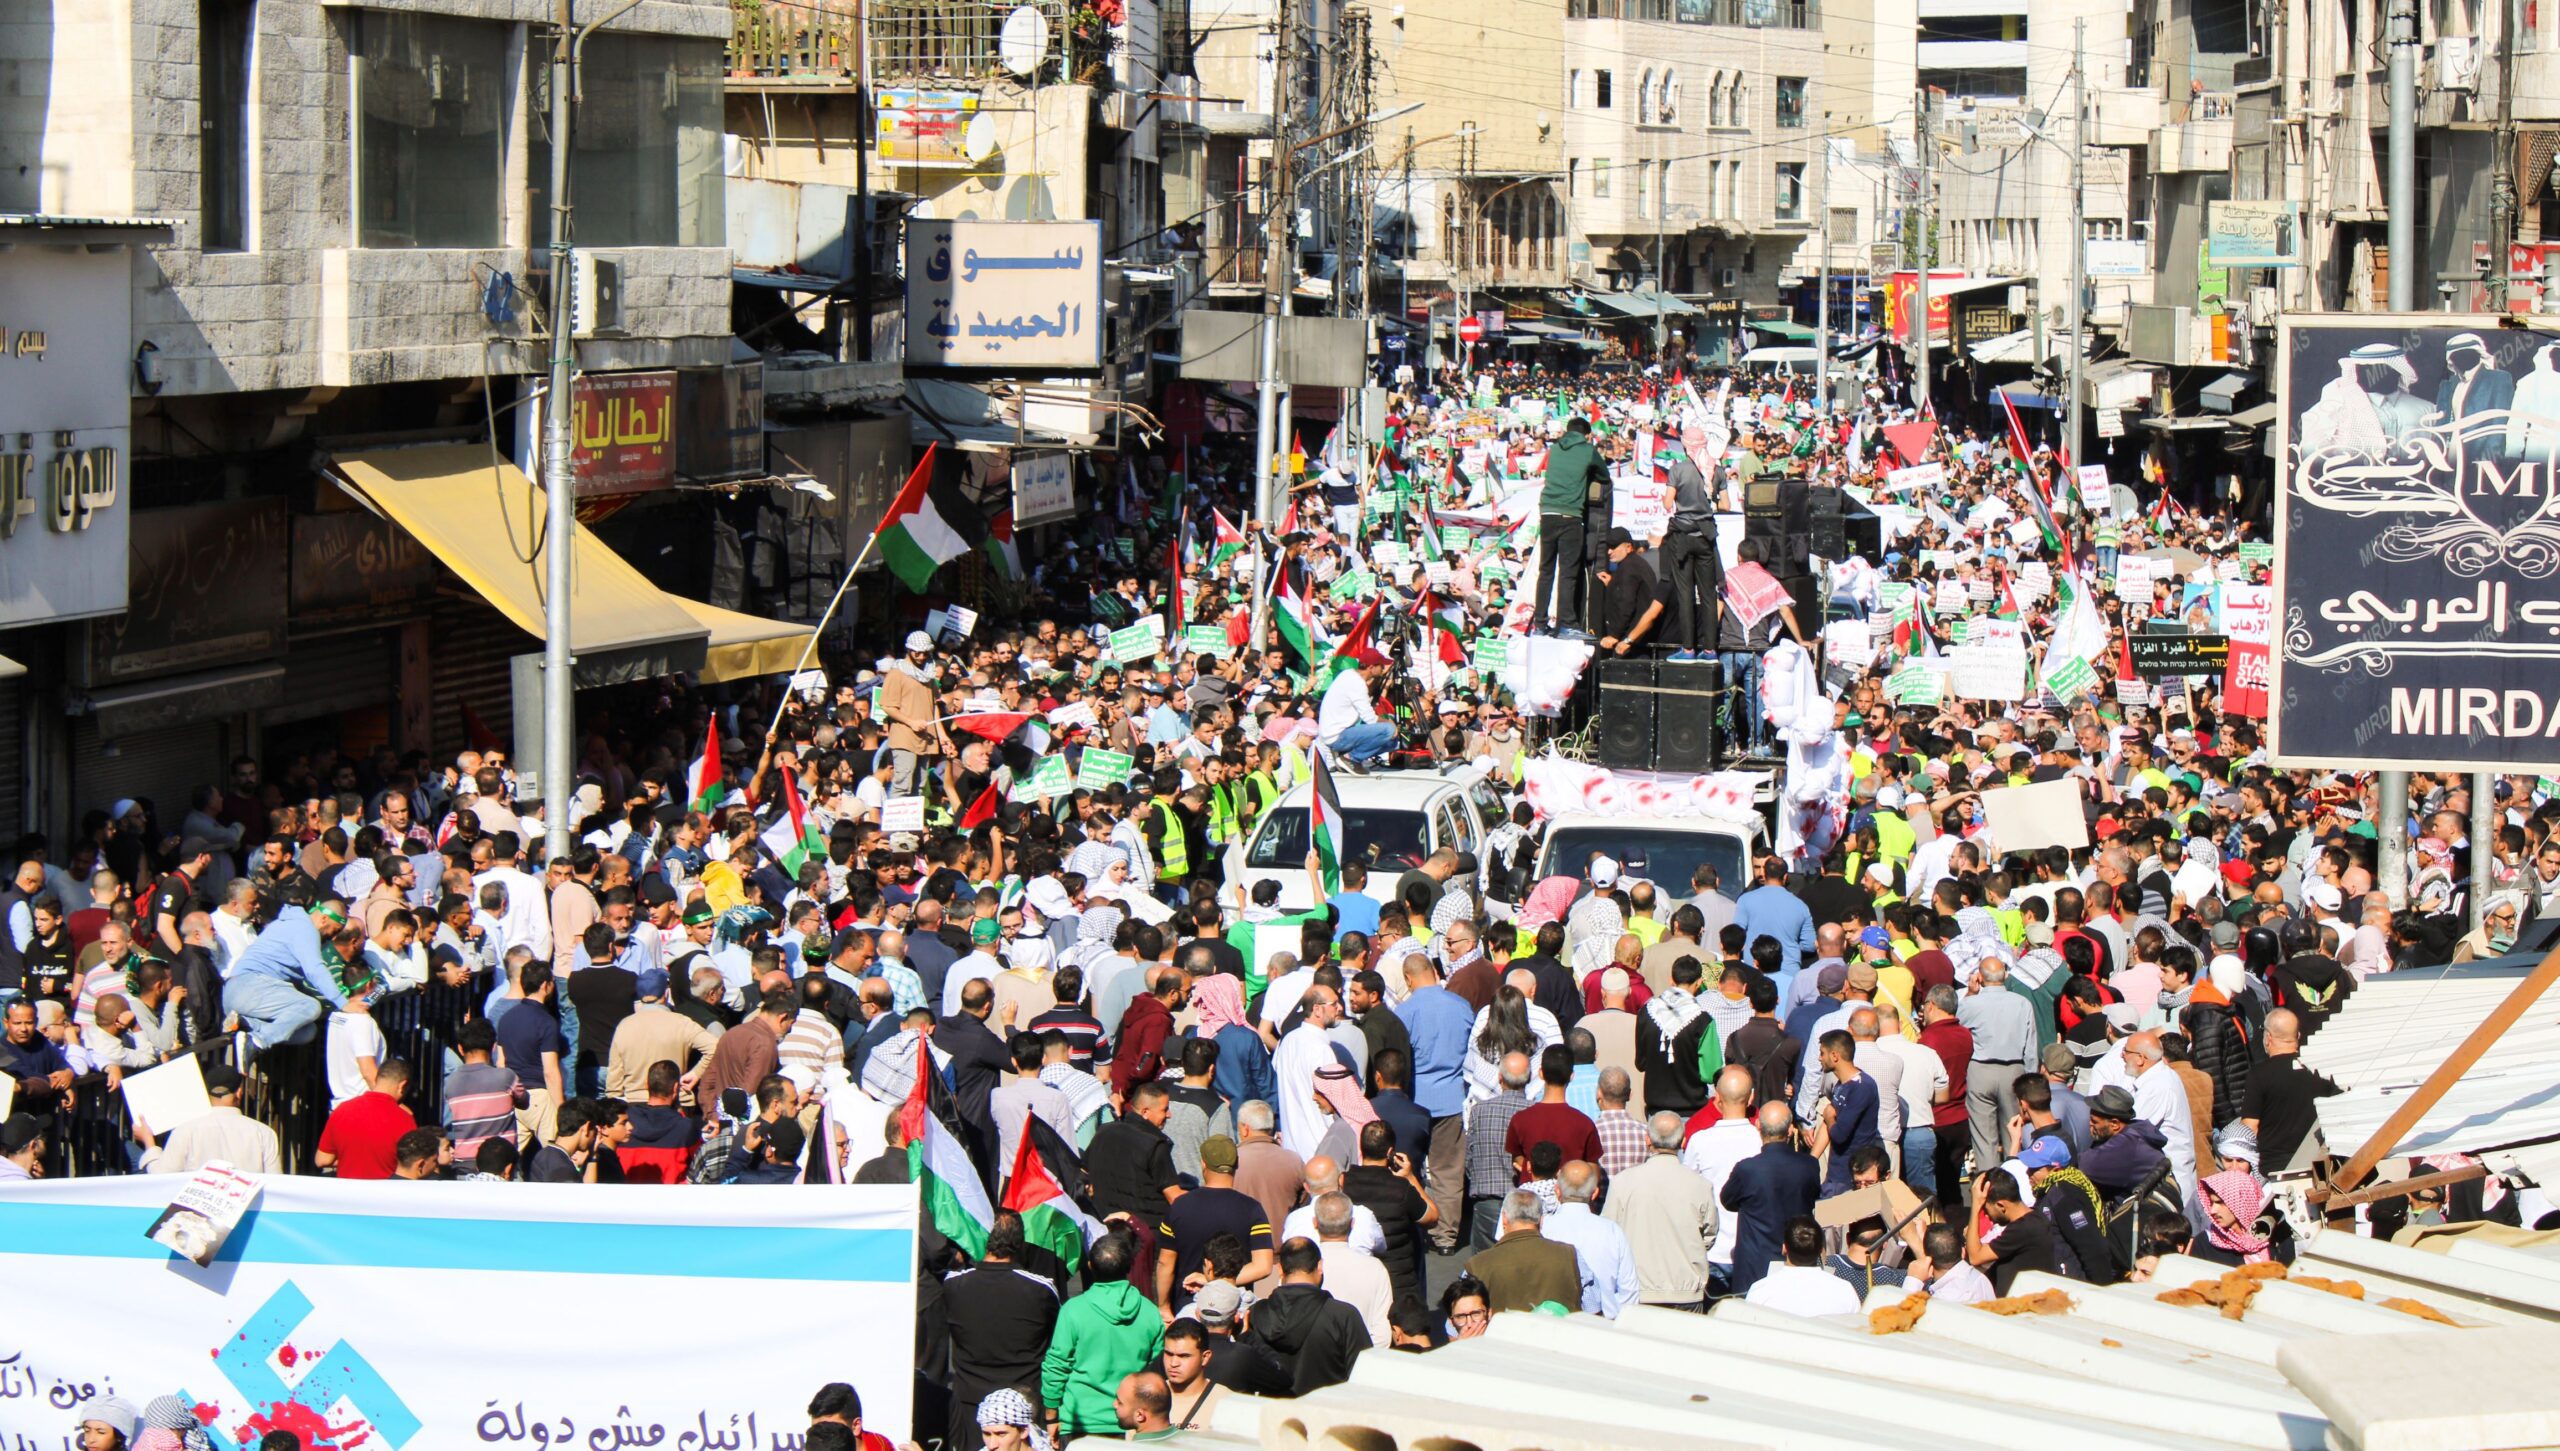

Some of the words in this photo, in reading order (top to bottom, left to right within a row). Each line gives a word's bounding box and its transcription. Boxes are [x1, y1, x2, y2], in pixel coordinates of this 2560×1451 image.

[926, 233, 1084, 283] سوق
[15, 330, 47, 362] بسم
[926, 298, 1081, 352] الحميدية
[47, 429, 118, 533] سوق
[2470, 460, 2541, 498] M
[2320, 579, 2507, 634] العربي
[2187, 638, 2229, 656] غزة
